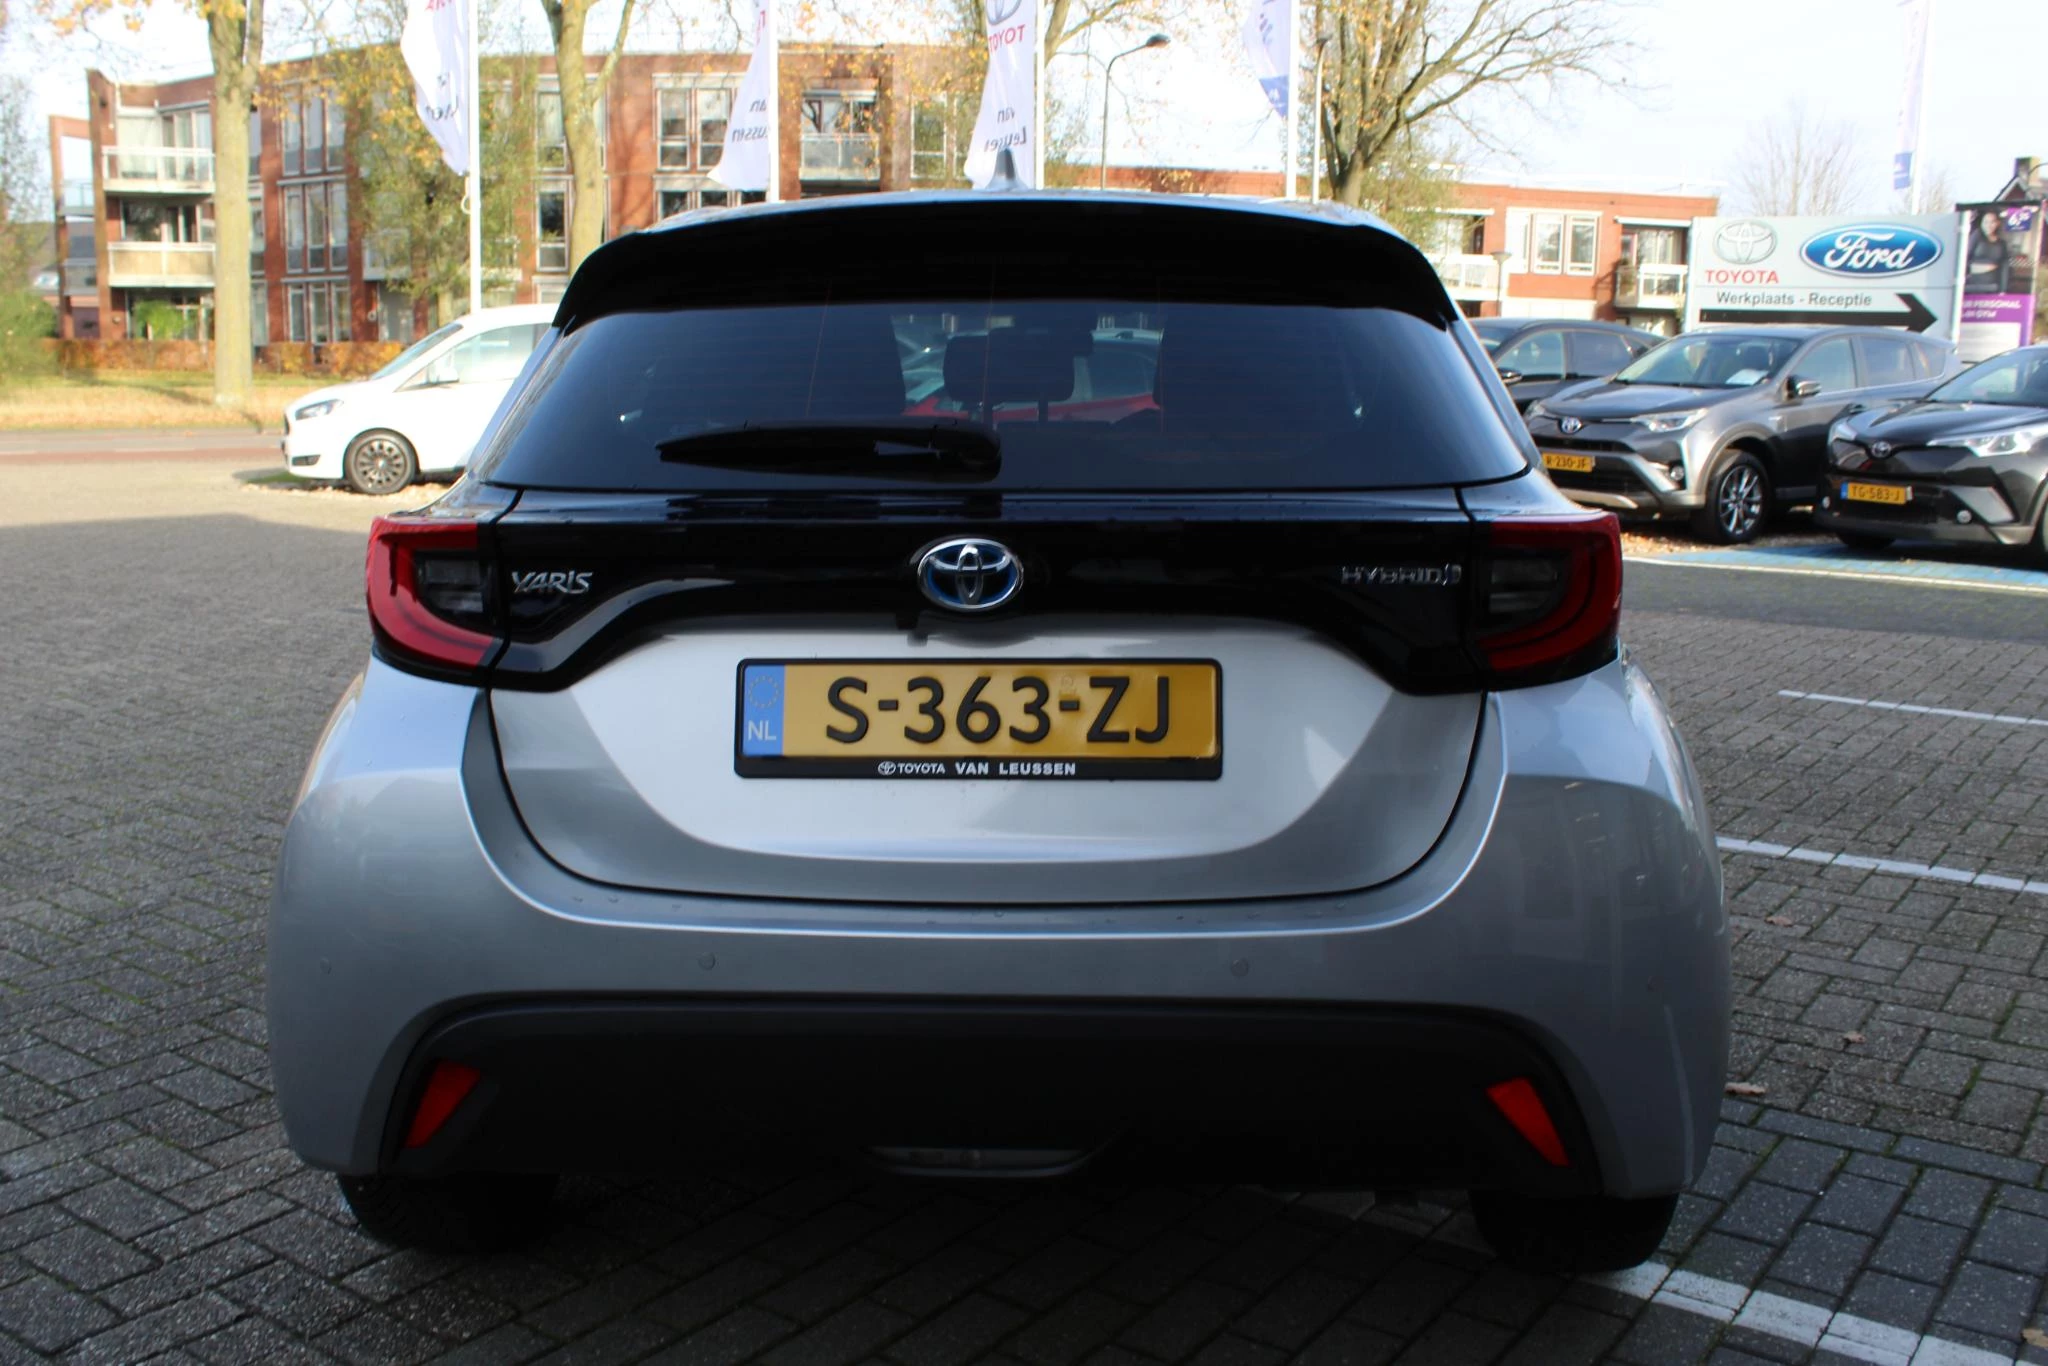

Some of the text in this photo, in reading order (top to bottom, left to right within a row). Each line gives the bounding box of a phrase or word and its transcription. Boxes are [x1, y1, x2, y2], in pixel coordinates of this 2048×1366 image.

[1823, 231, 1917, 269] Ford
[1705, 269, 1780, 284] TOYOTA
[1716, 291, 1795, 307] Werkplaats
[1808, 292, 1872, 308] Receptie
[1852, 485, 1900, 501] TG-583-J
[511, 570, 593, 594] YARIS
[1340, 566, 1441, 584] HYBRID
[826, 675, 1170, 744] S-363-ZJ
[748, 720, 777, 740] NL
[898, 762, 1076, 775] TOYOTA VAN LEUSSEN
